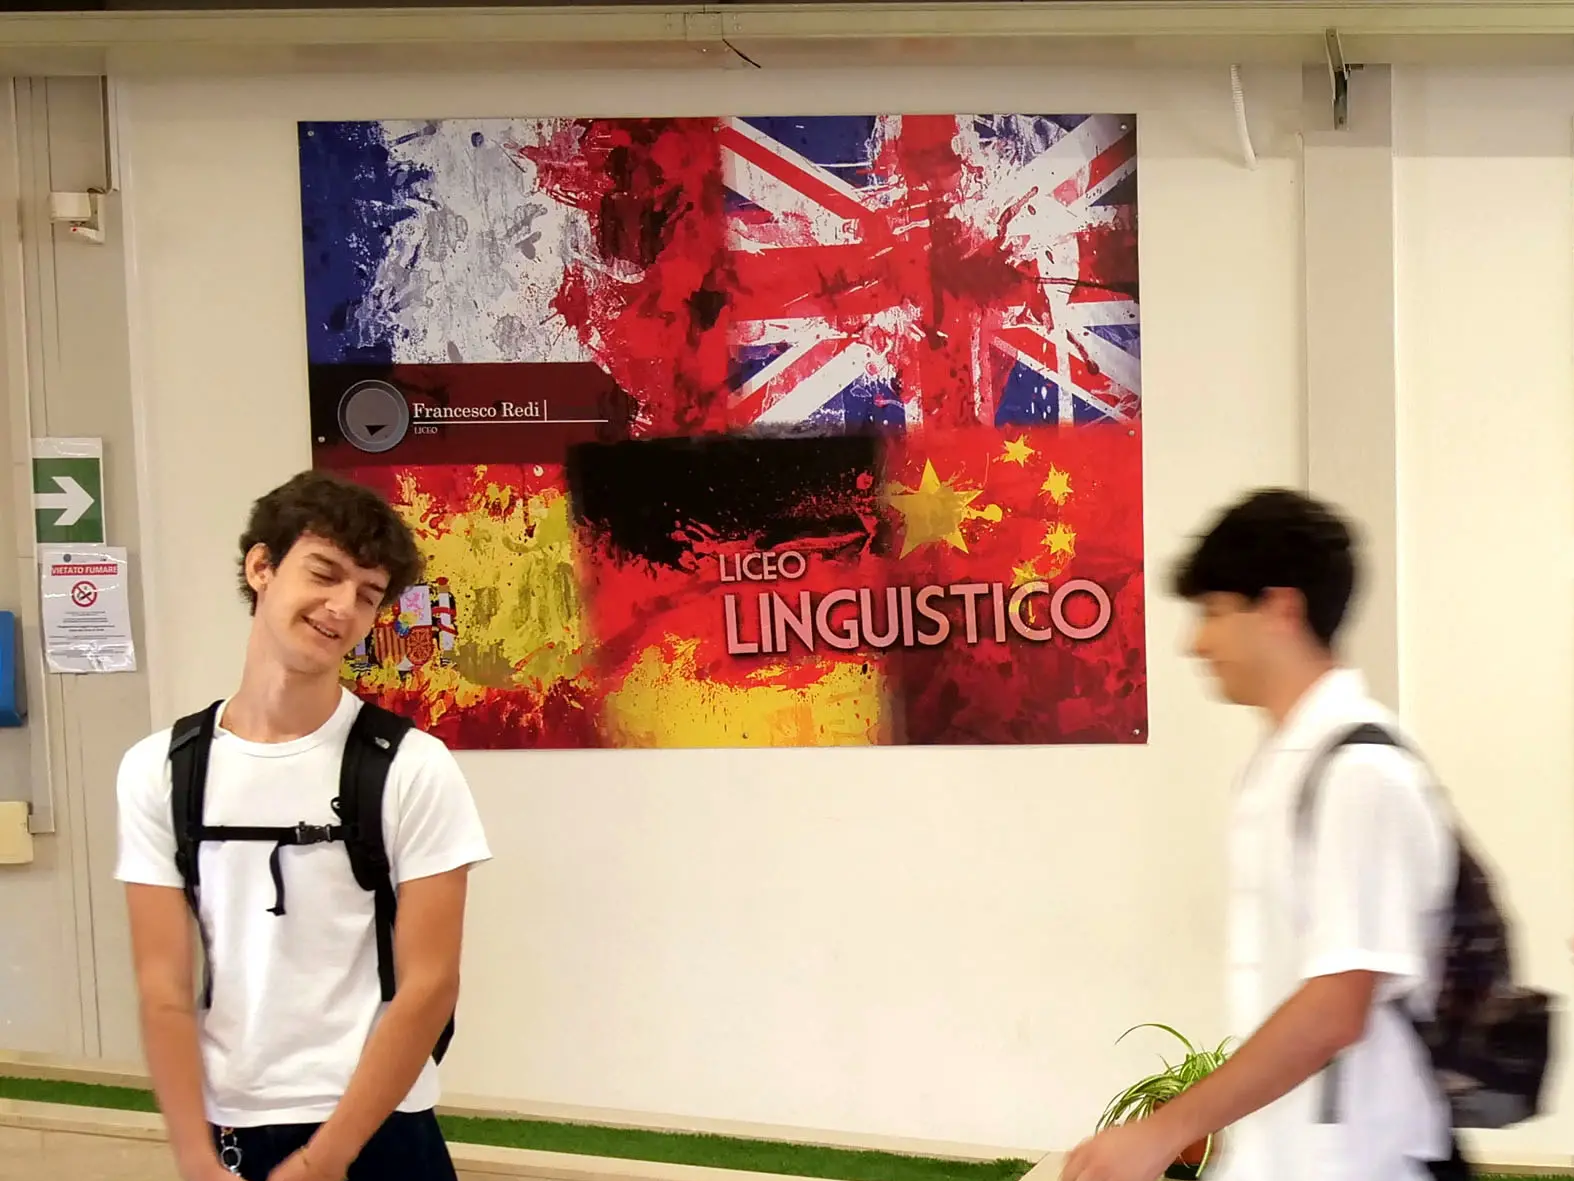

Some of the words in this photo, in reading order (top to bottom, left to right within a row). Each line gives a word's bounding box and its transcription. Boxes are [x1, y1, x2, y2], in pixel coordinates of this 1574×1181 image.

[412, 402, 497, 418] Francesco
[501, 401, 540, 418] Redi
[414, 426, 438, 435] LICEO
[719, 550, 806, 582] LICEO
[724, 578, 1112, 655] LINGUISTICO
